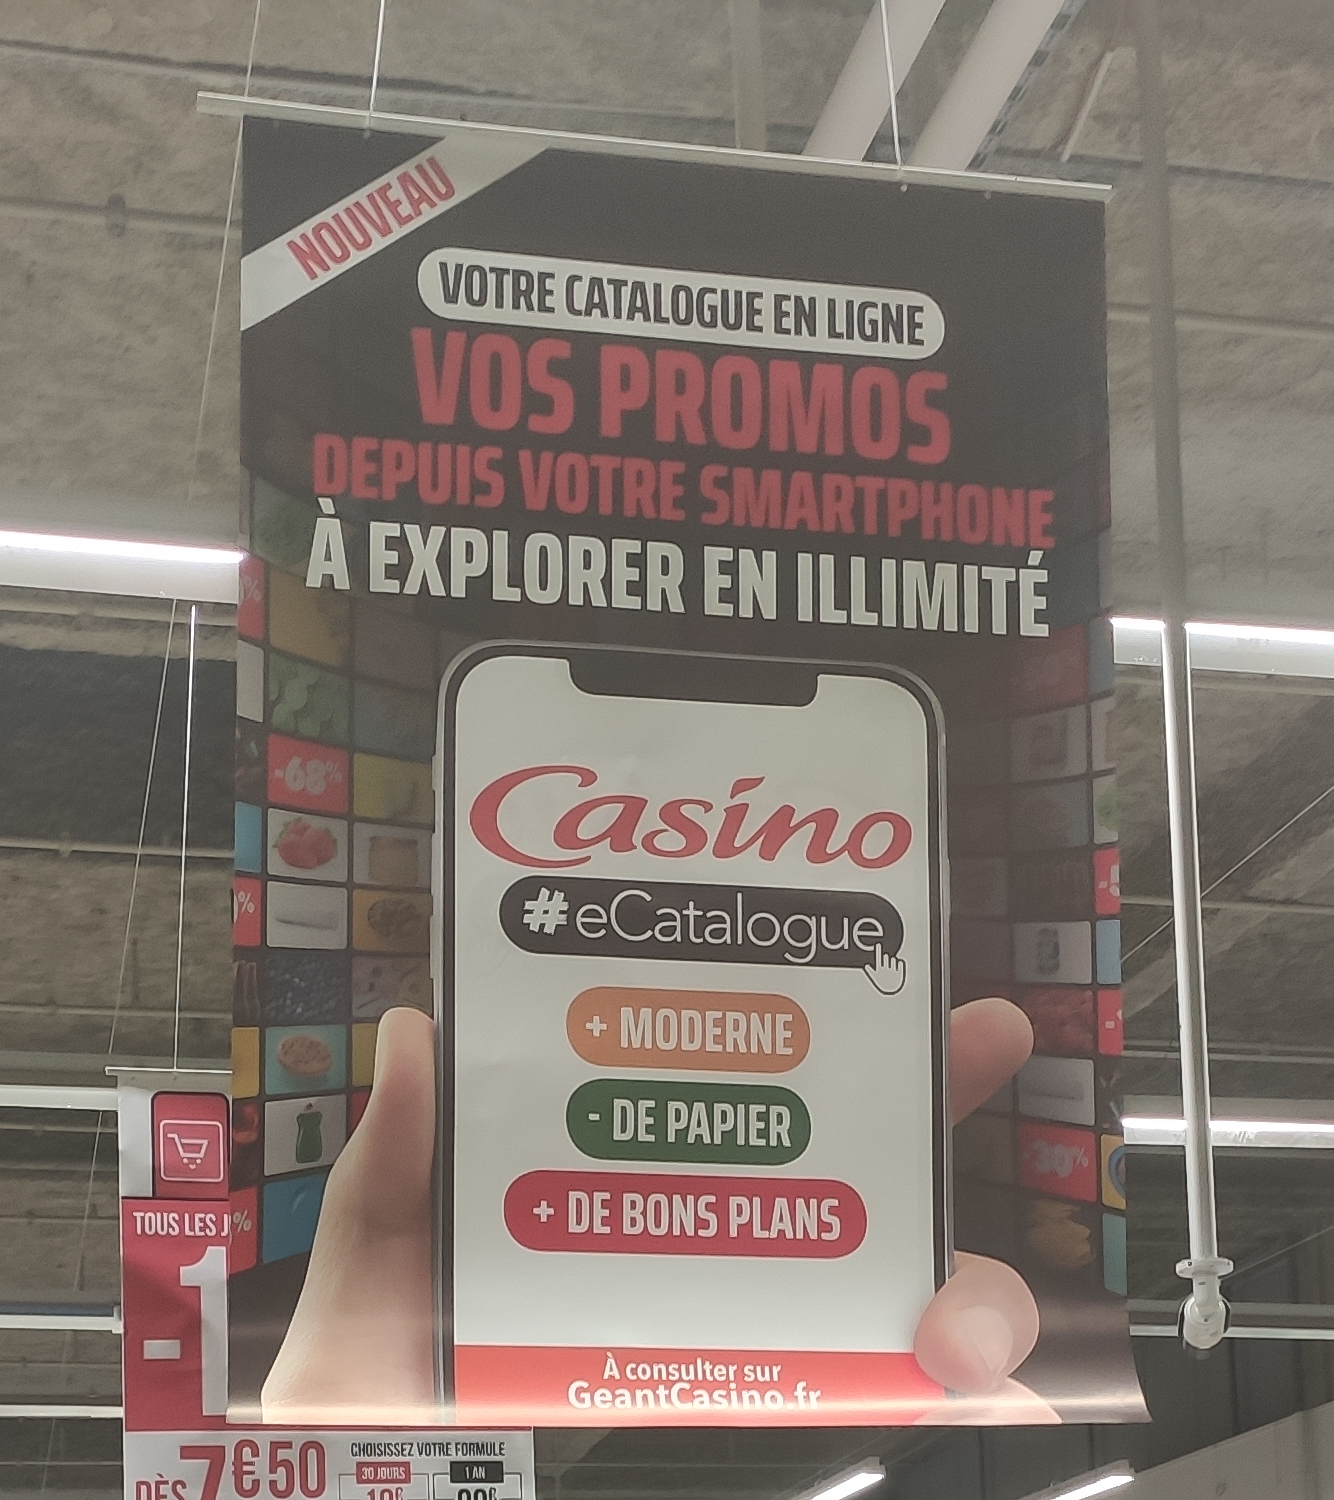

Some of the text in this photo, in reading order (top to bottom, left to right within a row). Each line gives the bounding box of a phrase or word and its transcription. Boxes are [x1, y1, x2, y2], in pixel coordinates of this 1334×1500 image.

[286, 154, 456, 281] NOUVEAU
[439, 260, 926, 347] VOTRE CATALOGUE EN LIGNE
[411, 326, 952, 465] VOS PROMOS
[313, 433, 1057, 551] DEPUIS VOTRE SMARTPHONE
[305, 497, 1051, 639] À EXPLORER EN ILLIMITÉ
[274, 755, 343, 797] -68%
[469, 764, 913, 870] Casino
[619, 1006, 794, 1056] MODERNE
[612, 1098, 657, 1143] DE
[666, 1100, 793, 1149] PAPIER
[133, 1211, 180, 1237] TOUS
[184, 1211, 217, 1237] LES
[567, 1190, 611, 1235] DE
[622, 1192, 718, 1238] BONS
[728, 1195, 842, 1242] PLANS
[602, 1351, 782, 1384] À consulter sur
[350, 1441, 506, 1458] CHOISISSEZ VOTRE FORMULE
[360, 1465, 406, 1481] 30 JOURS
[471, 1465, 486, 1480] AN
